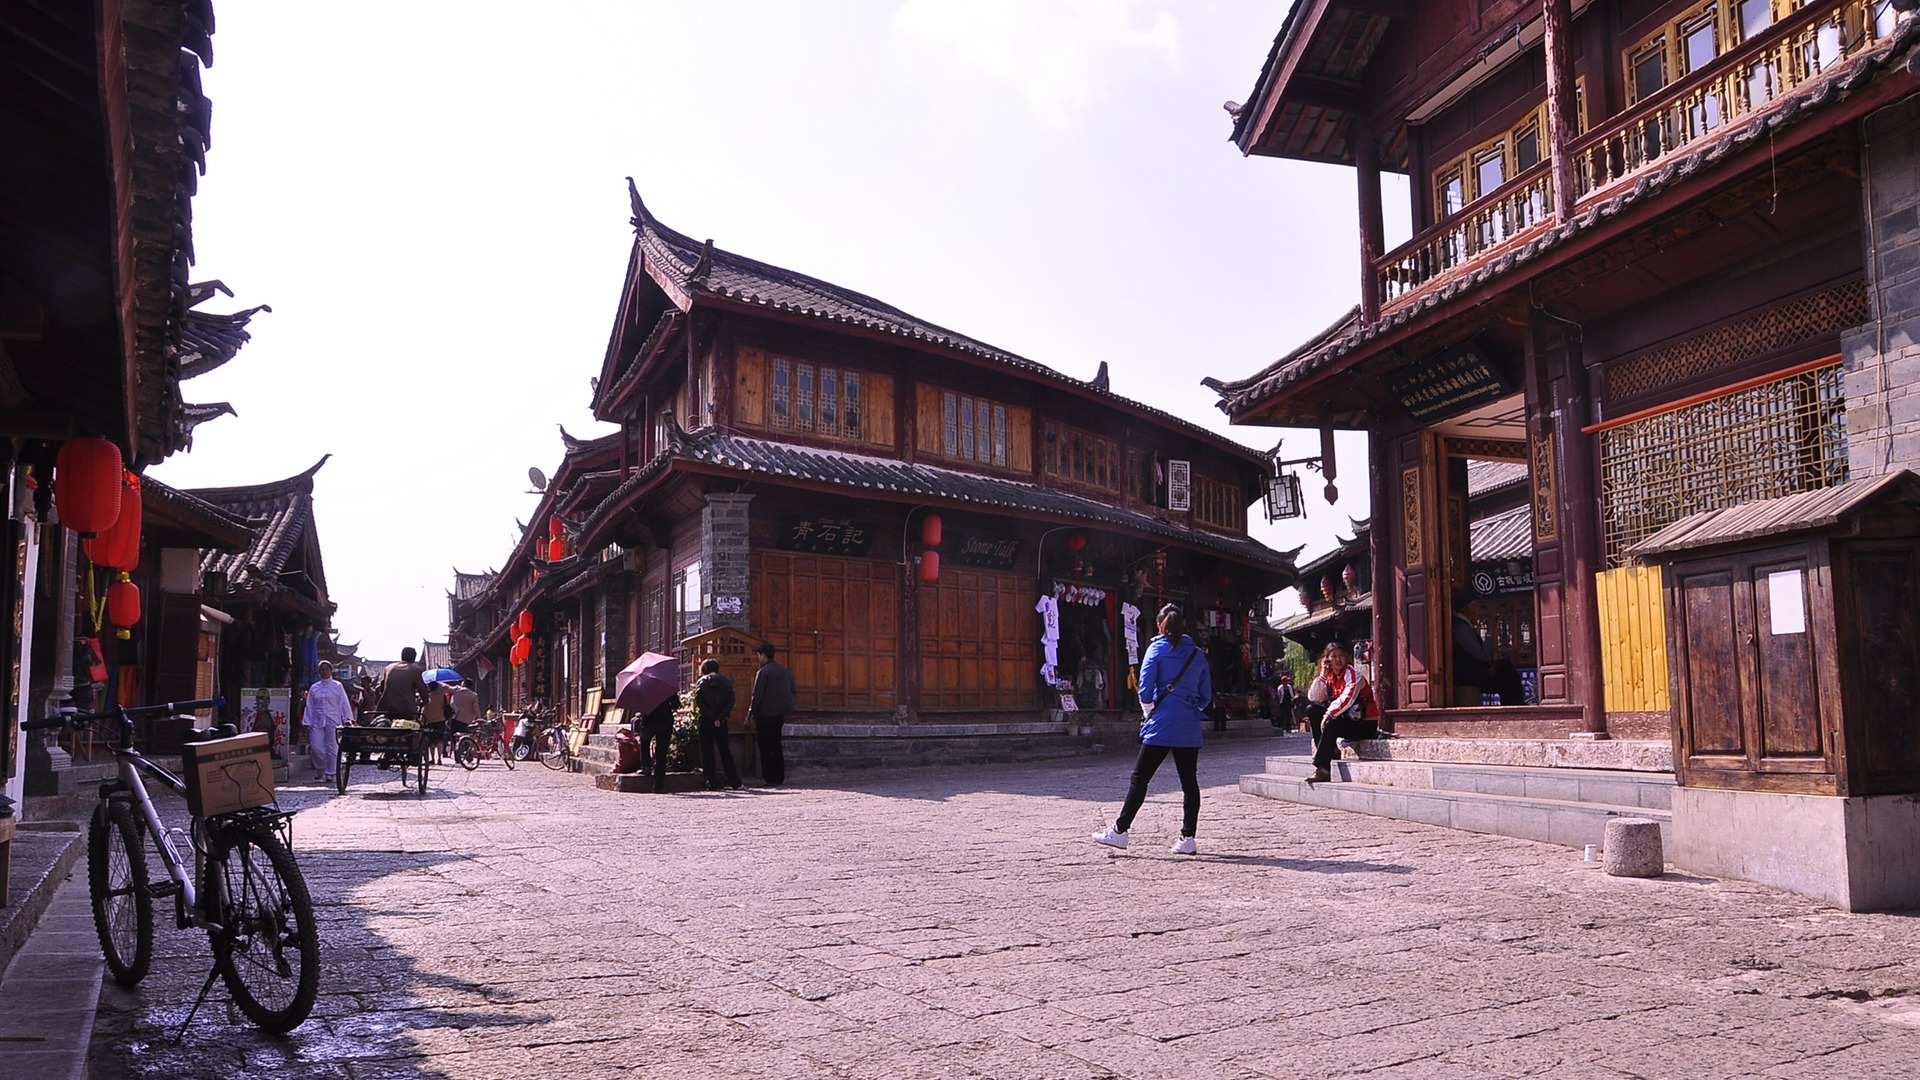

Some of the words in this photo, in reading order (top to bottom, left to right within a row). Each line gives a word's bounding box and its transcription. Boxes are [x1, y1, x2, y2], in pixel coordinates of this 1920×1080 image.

[792, 520, 865, 545] 青石記
[962, 536, 993, 554] Stone
[993, 540, 1018, 563] Talk
